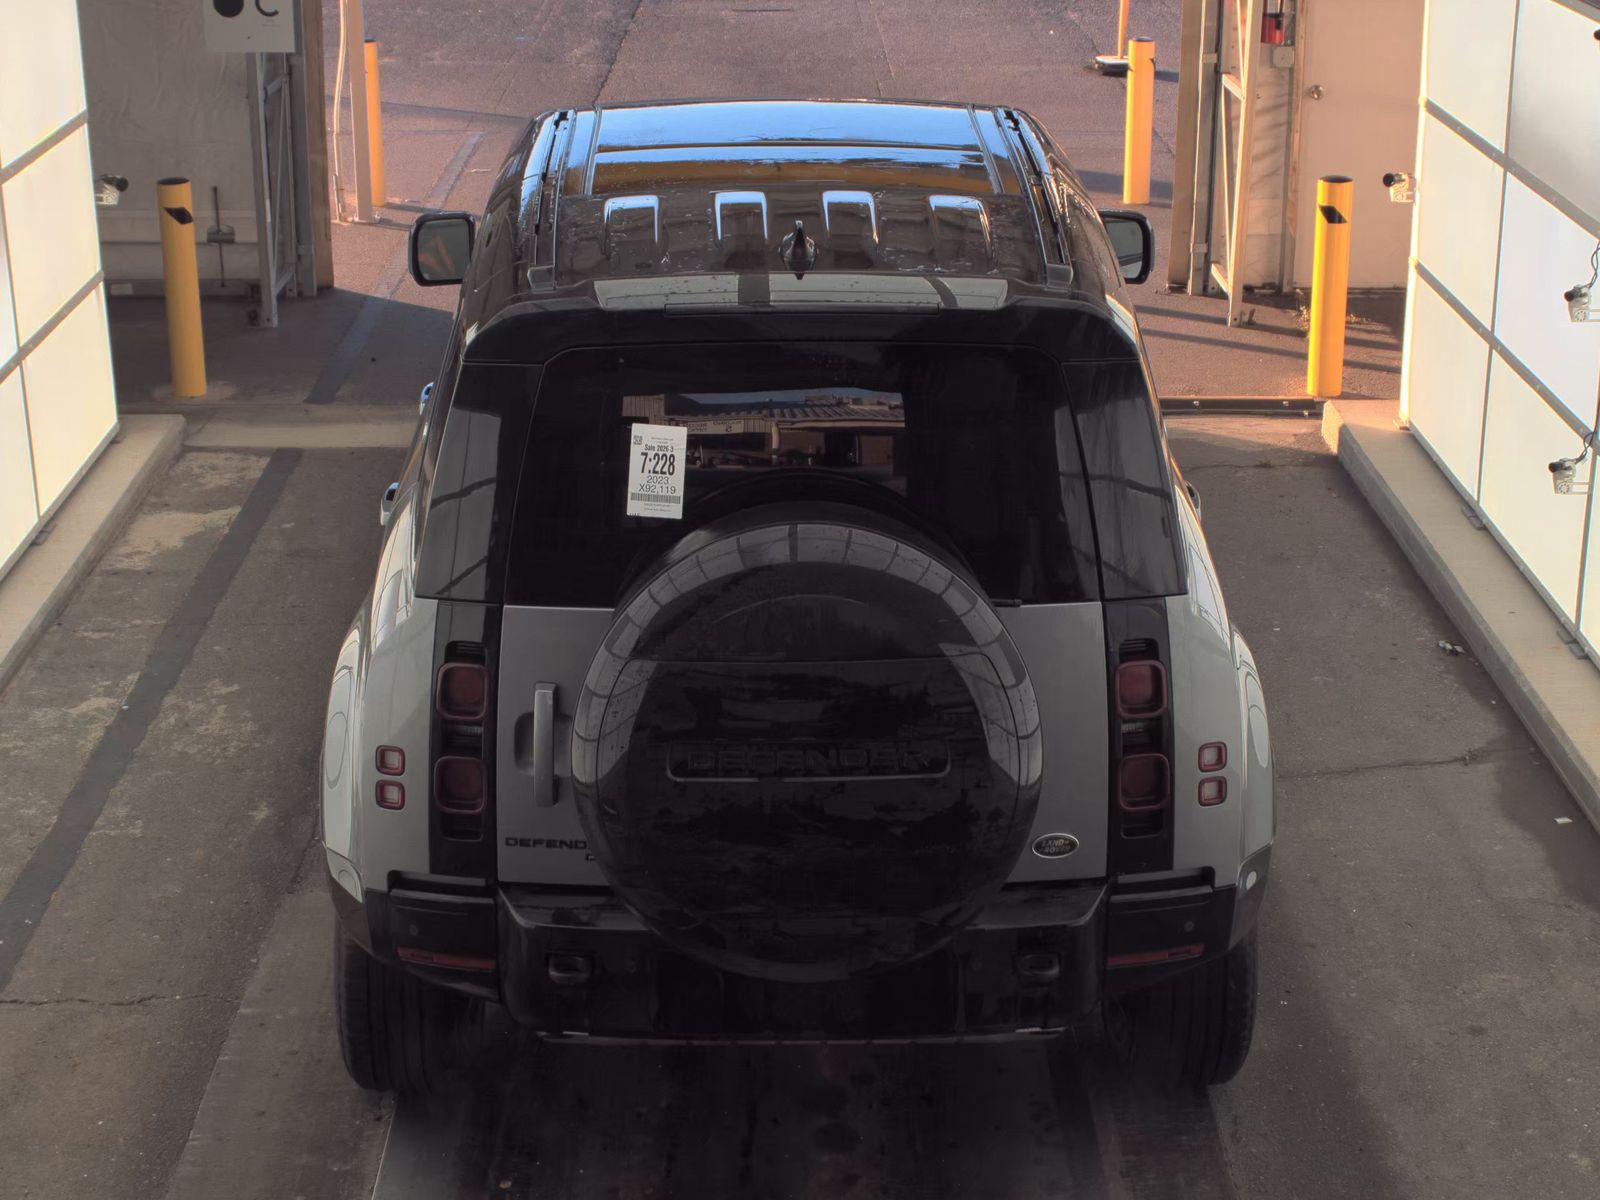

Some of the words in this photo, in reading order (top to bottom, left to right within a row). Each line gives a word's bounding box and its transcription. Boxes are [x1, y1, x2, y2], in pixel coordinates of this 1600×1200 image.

[644, 444, 655, 452] Sale
[641, 452, 675, 476] 7:228
[646, 475, 670, 485] 2023
[639, 483, 676, 495] X92,119
[689, 749, 930, 775] DEFENDER
[505, 837, 590, 850] DEFEND
